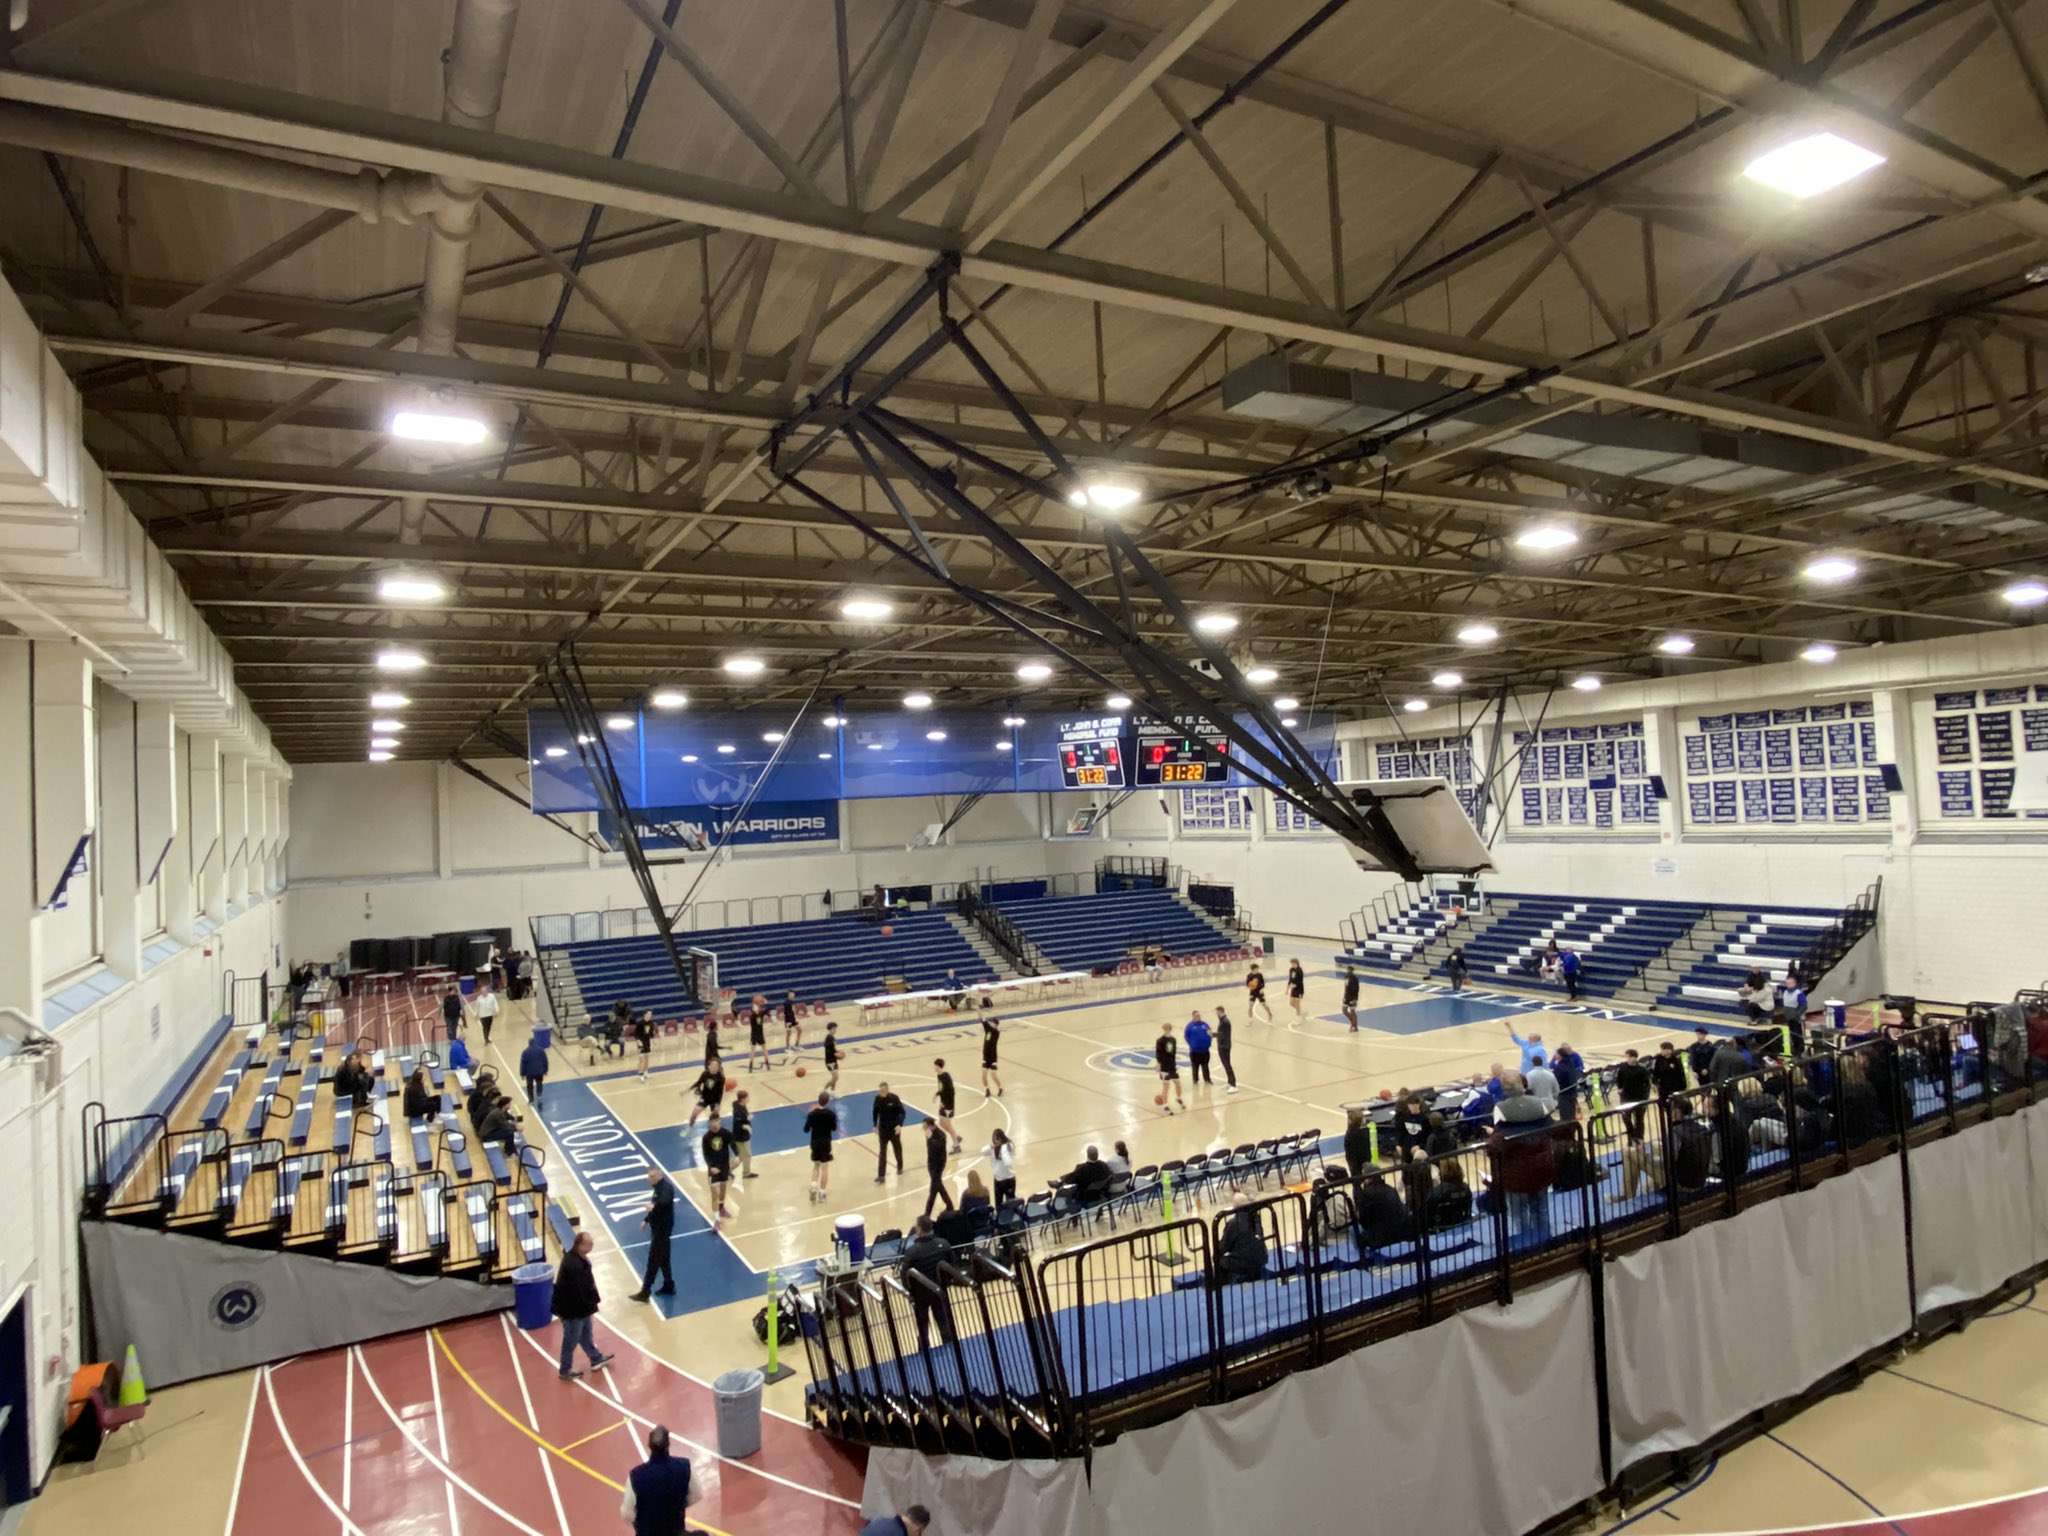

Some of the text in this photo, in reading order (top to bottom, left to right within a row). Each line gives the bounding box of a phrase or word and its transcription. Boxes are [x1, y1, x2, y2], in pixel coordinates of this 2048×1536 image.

[1060, 723, 1072, 733] LT.
[1133, 716, 1150, 725] LT.
[1078, 768, 1105, 784] 31:22
[1163, 764, 1204, 781] 31:22
[712, 817, 826, 834] WARRIORS
[550, 1114, 656, 1222] WILTON
